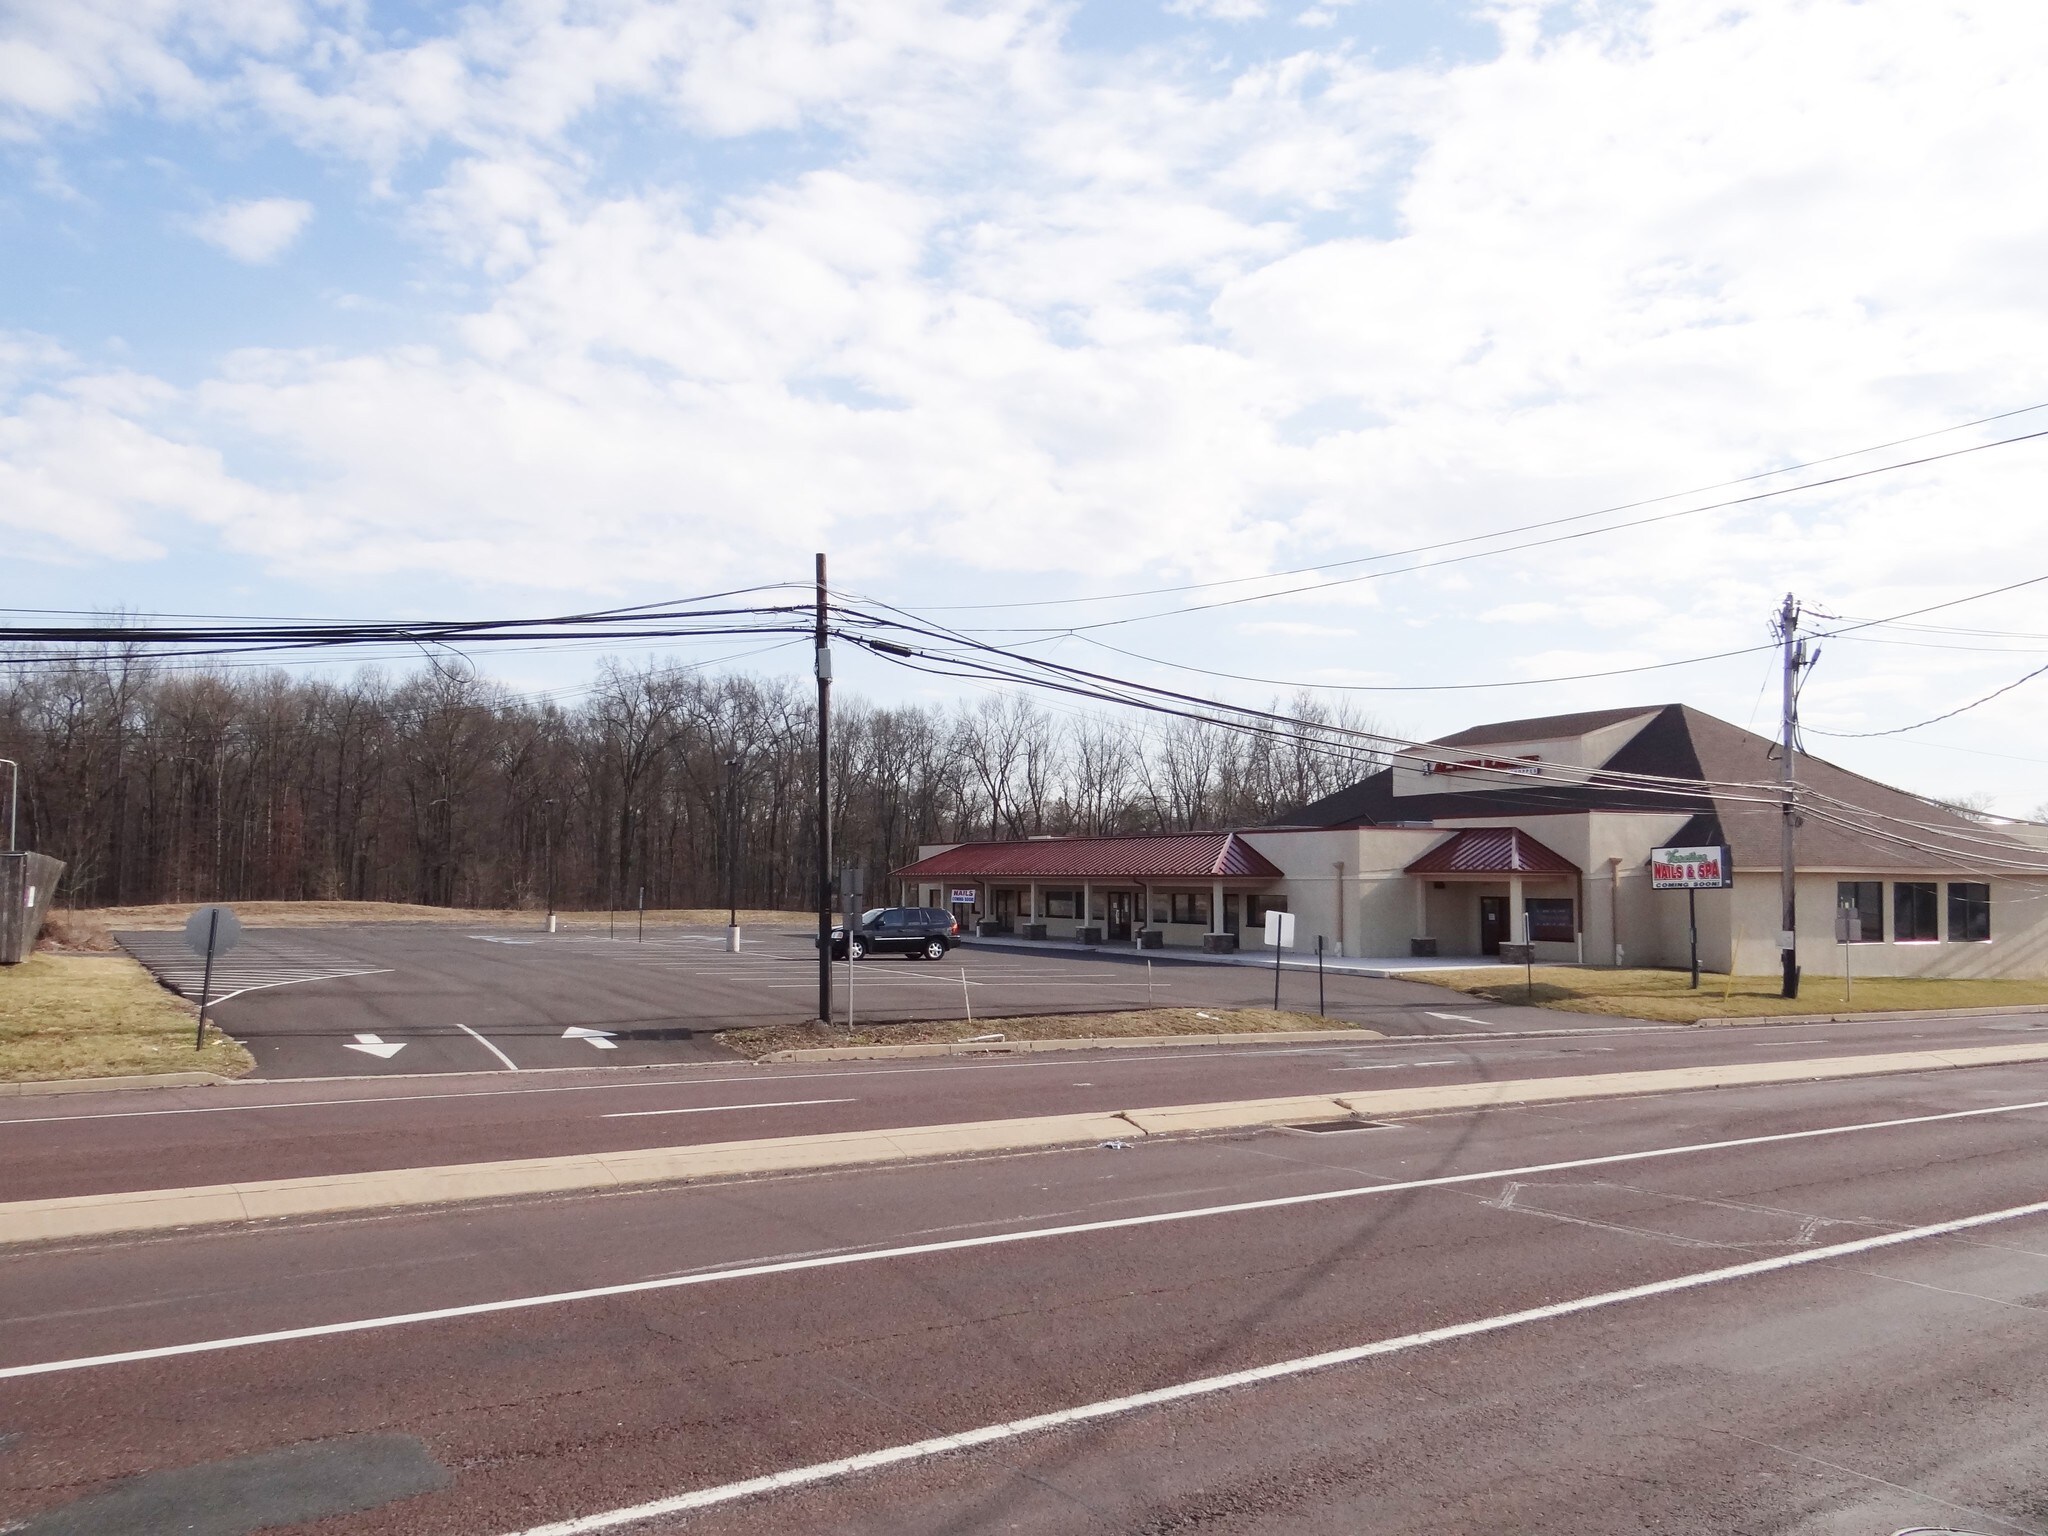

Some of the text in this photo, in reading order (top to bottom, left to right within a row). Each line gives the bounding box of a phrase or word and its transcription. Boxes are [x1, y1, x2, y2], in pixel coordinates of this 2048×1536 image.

[1653, 859, 1720, 880] NAILS & SPA
